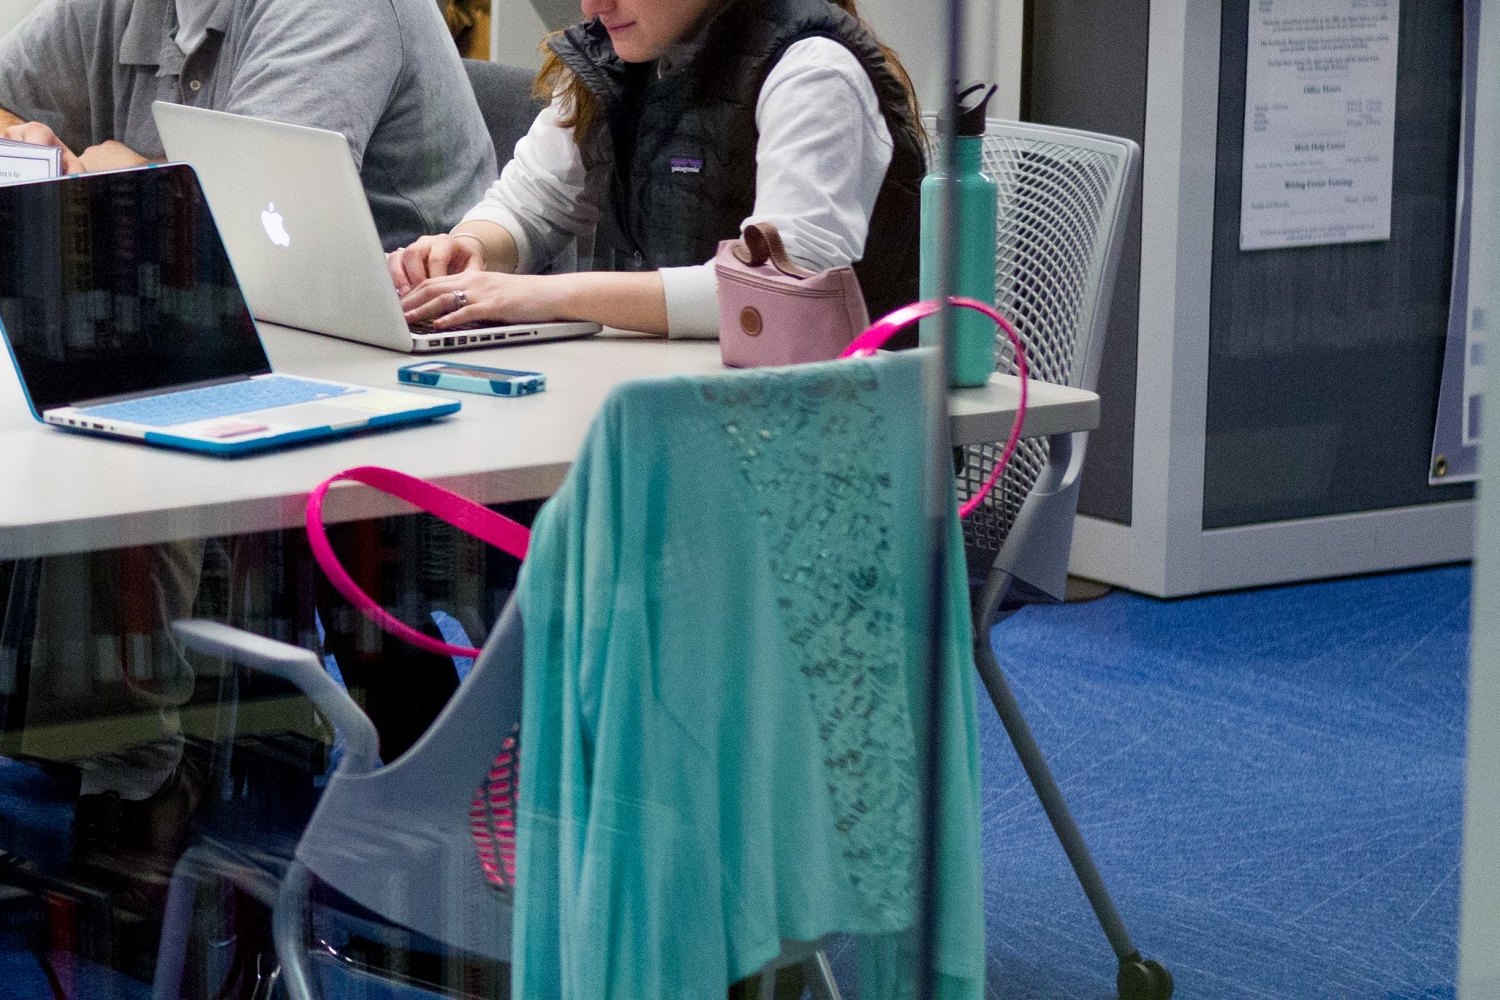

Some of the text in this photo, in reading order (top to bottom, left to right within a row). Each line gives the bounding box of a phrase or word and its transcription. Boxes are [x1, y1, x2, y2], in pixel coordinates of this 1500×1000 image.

[1303, 84, 1342, 94] Office Hours
[1294, 141, 1346, 152] Math Help Center
